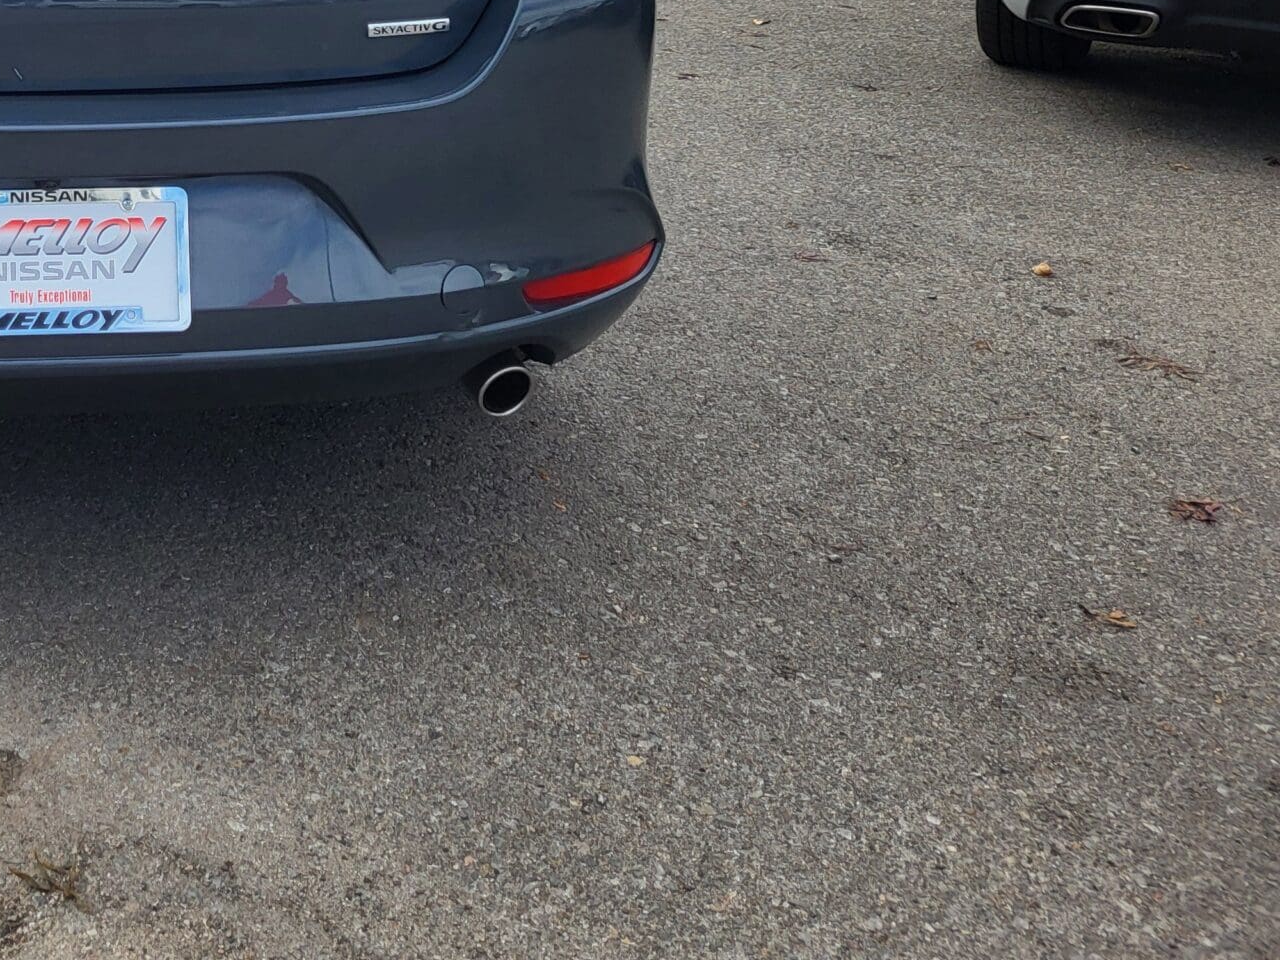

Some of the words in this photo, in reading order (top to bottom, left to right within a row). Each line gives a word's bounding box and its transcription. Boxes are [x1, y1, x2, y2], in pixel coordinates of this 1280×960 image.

[10, 190, 88, 203] NISSAN
[10, 290, 34, 305] Truly
[38, 289, 91, 304] Exceptional
